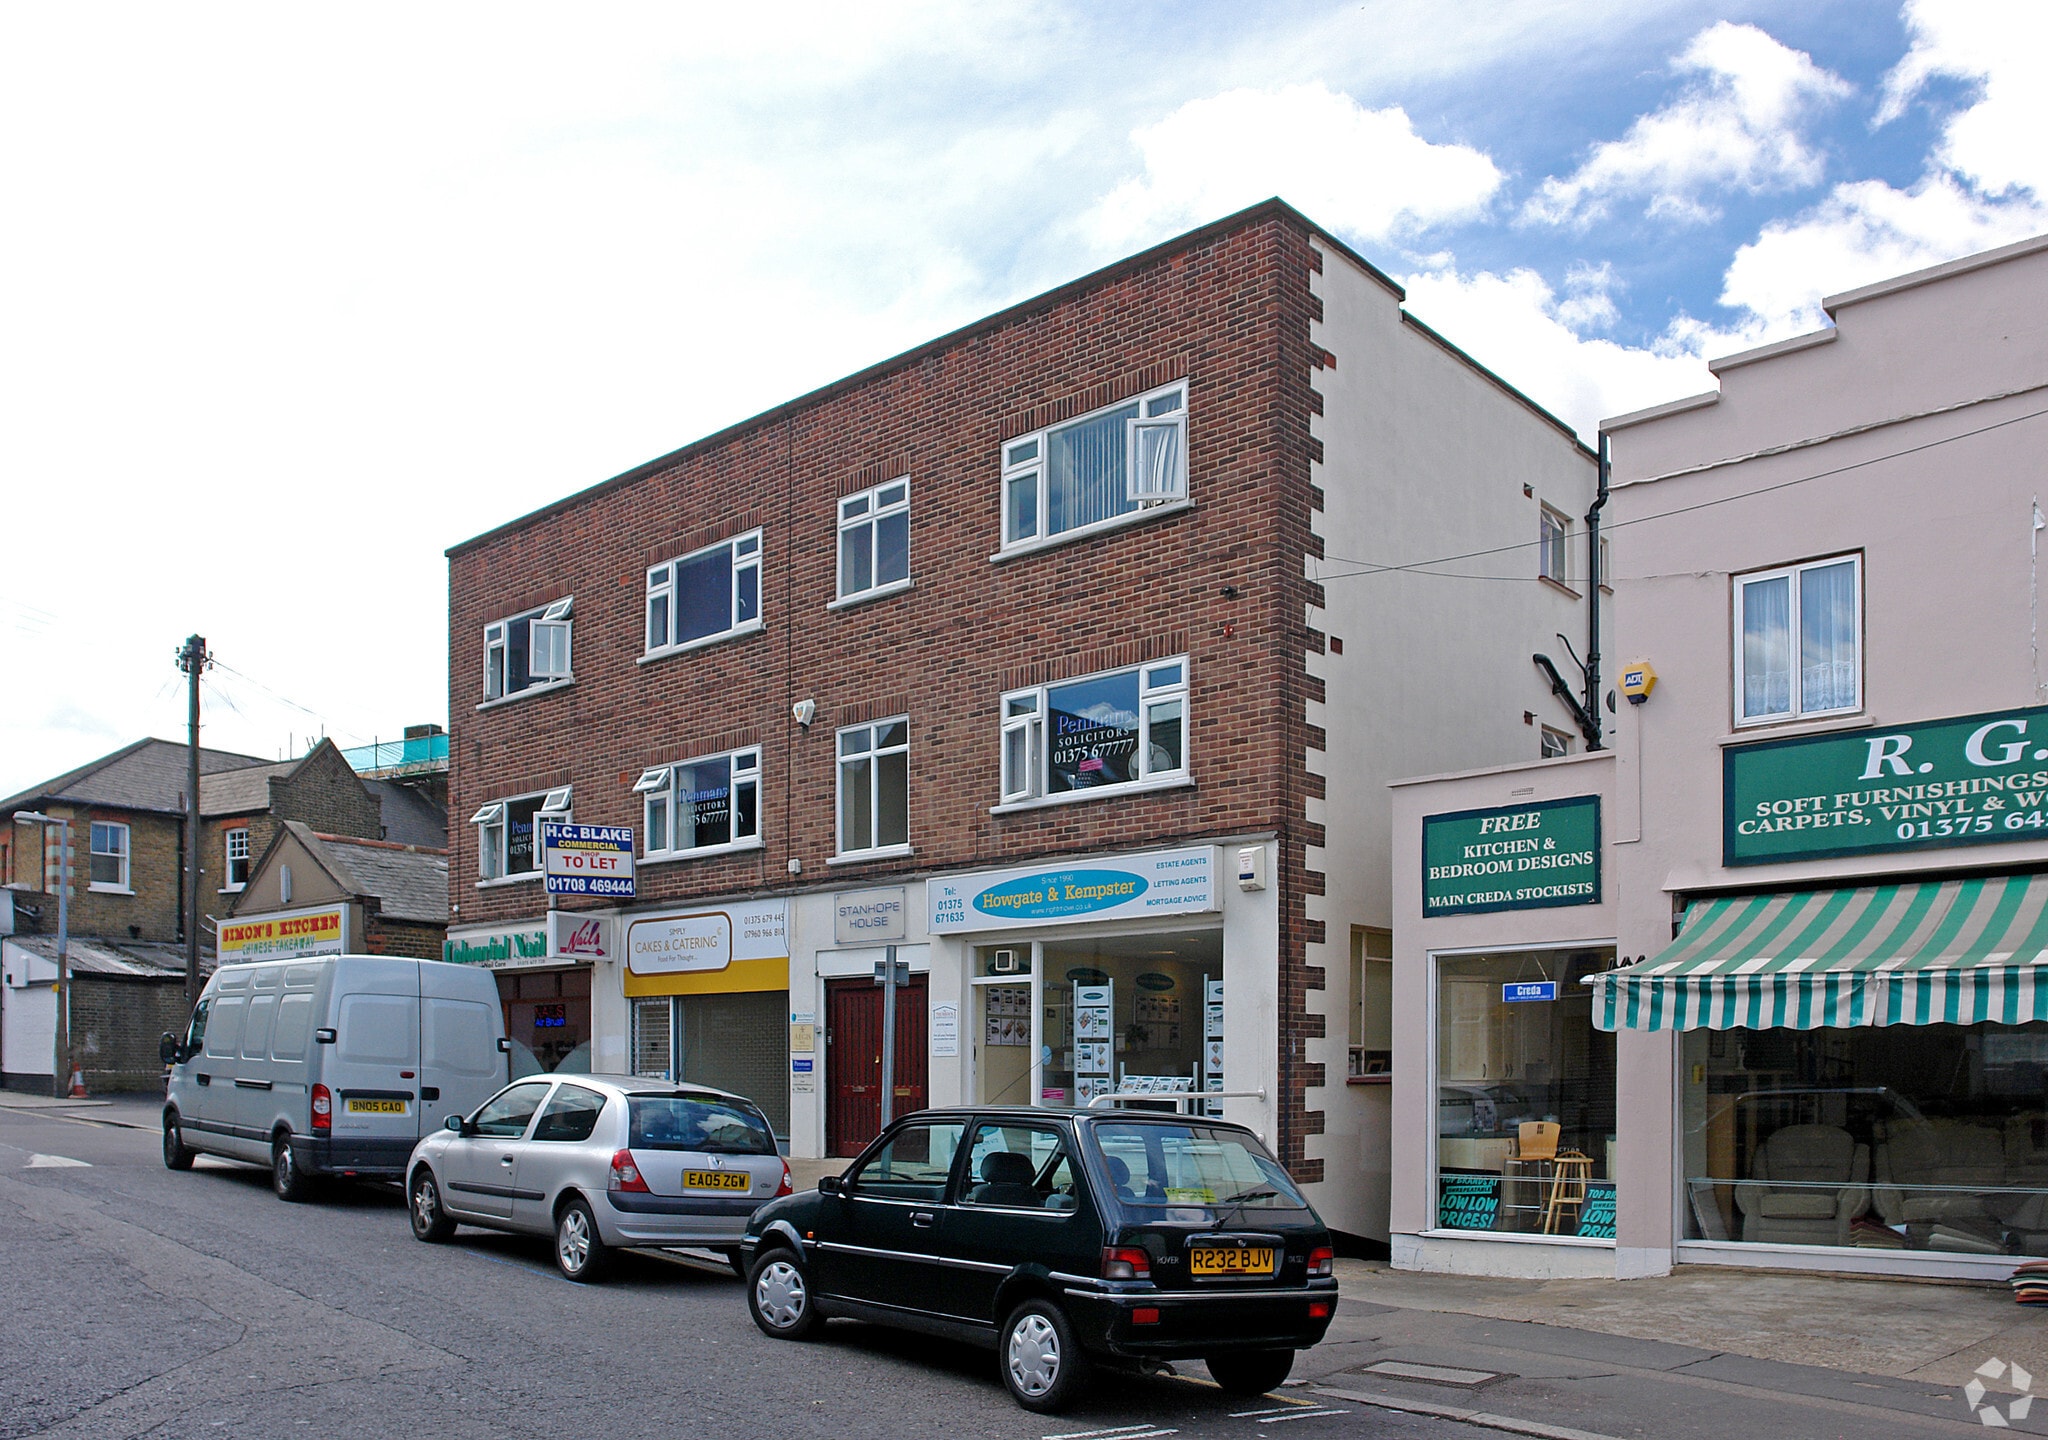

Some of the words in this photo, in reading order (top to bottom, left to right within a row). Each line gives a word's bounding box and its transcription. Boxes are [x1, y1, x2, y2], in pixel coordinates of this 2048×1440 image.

[1626, 674, 1643, 684] ADT
[1057, 710, 1134, 736] Penmans
[1058, 727, 1130, 747] SOLICITORS
[1054, 746, 1088, 764] 01375
[1091, 738, 1134, 759] 677777
[1858, 734, 1934, 780] R.
[1965, 719, 2048, 766] G.
[1756, 796, 1826, 817] SOFT
[1834, 771, 2048, 809] FURNISHINGS
[1737, 809, 1872, 835] CARPETS,
[1879, 798, 1974, 821] VINYL
[1982, 795, 2006, 811] &
[2014, 790, 2048, 808] W
[1479, 812, 1541, 835] FREE
[1897, 814, 1993, 839] 01375
[2004, 810, 2048, 830] 64
[546, 825, 577, 839] H.C.
[580, 828, 631, 842] BLAKE
[558, 839, 620, 851] COMMERCIAL
[1464, 838, 1539, 858] KITCHEN
[1543, 837, 1556, 850] &
[562, 856, 584, 869] TO
[589, 858, 618, 870] LET
[1156, 860, 1180, 869] ESTATE
[1182, 857, 1207, 867] AGENTS
[1429, 859, 1514, 880] BEDROOM
[1517, 851, 1594, 872] DESIGNS
[548, 877, 586, 891] 01708
[589, 879, 633, 893] 469444
[1153, 879, 1178, 888] LETTING
[1180, 876, 1207, 886] AGENTS
[944, 887, 957, 896] Tel:
[982, 889, 1043, 909] Howgate
[1048, 886, 1059, 901] &
[1065, 880, 1136, 901] Kempster
[1429, 894, 1464, 908] MAIN
[1467, 890, 1514, 905] CREDA
[1516, 882, 1594, 900] STOCKISTS
[938, 899, 963, 911] 01375
[1146, 897, 1181, 906] MORTGAGE
[1183, 894, 1207, 903] ADVICE
[839, 901, 900, 917] STANHOPE
[744, 915, 760, 925] 01375
[762, 915, 772, 923] 679
[849, 916, 888, 929] HOUSE
[935, 912, 965, 924] 671635
[223, 923, 273, 942] SIMON'S
[279, 914, 340, 936] KITCHEN
[568, 920, 600, 952] Nails
[669, 928, 686, 936] SIMPLY
[744, 931, 761, 939] 07960
[242, 941, 273, 955] CHINESE
[276, 935, 316, 952] TAKEAWAY
[635, 940, 662, 954] CAKES
[664, 940, 671, 952] &
[672, 935, 718, 951] CATERING
[1517, 985, 1542, 996] Creda
[352, 1102, 379, 1111] BN05
[689, 1173, 720, 1186] EA05
[723, 1175, 745, 1188] ZGW
[1588, 1189, 1605, 1199] TOP
[1440, 1194, 1469, 1209] LOW
[1468, 1196, 1499, 1212] LOW
[1440, 1210, 1495, 1228] PRICES!
[1581, 1209, 1616, 1224] LOW
[1157, 1256, 1180, 1265] ROVER
[1193, 1250, 1236, 1268] R232
[1240, 1250, 1271, 1268] BJV
